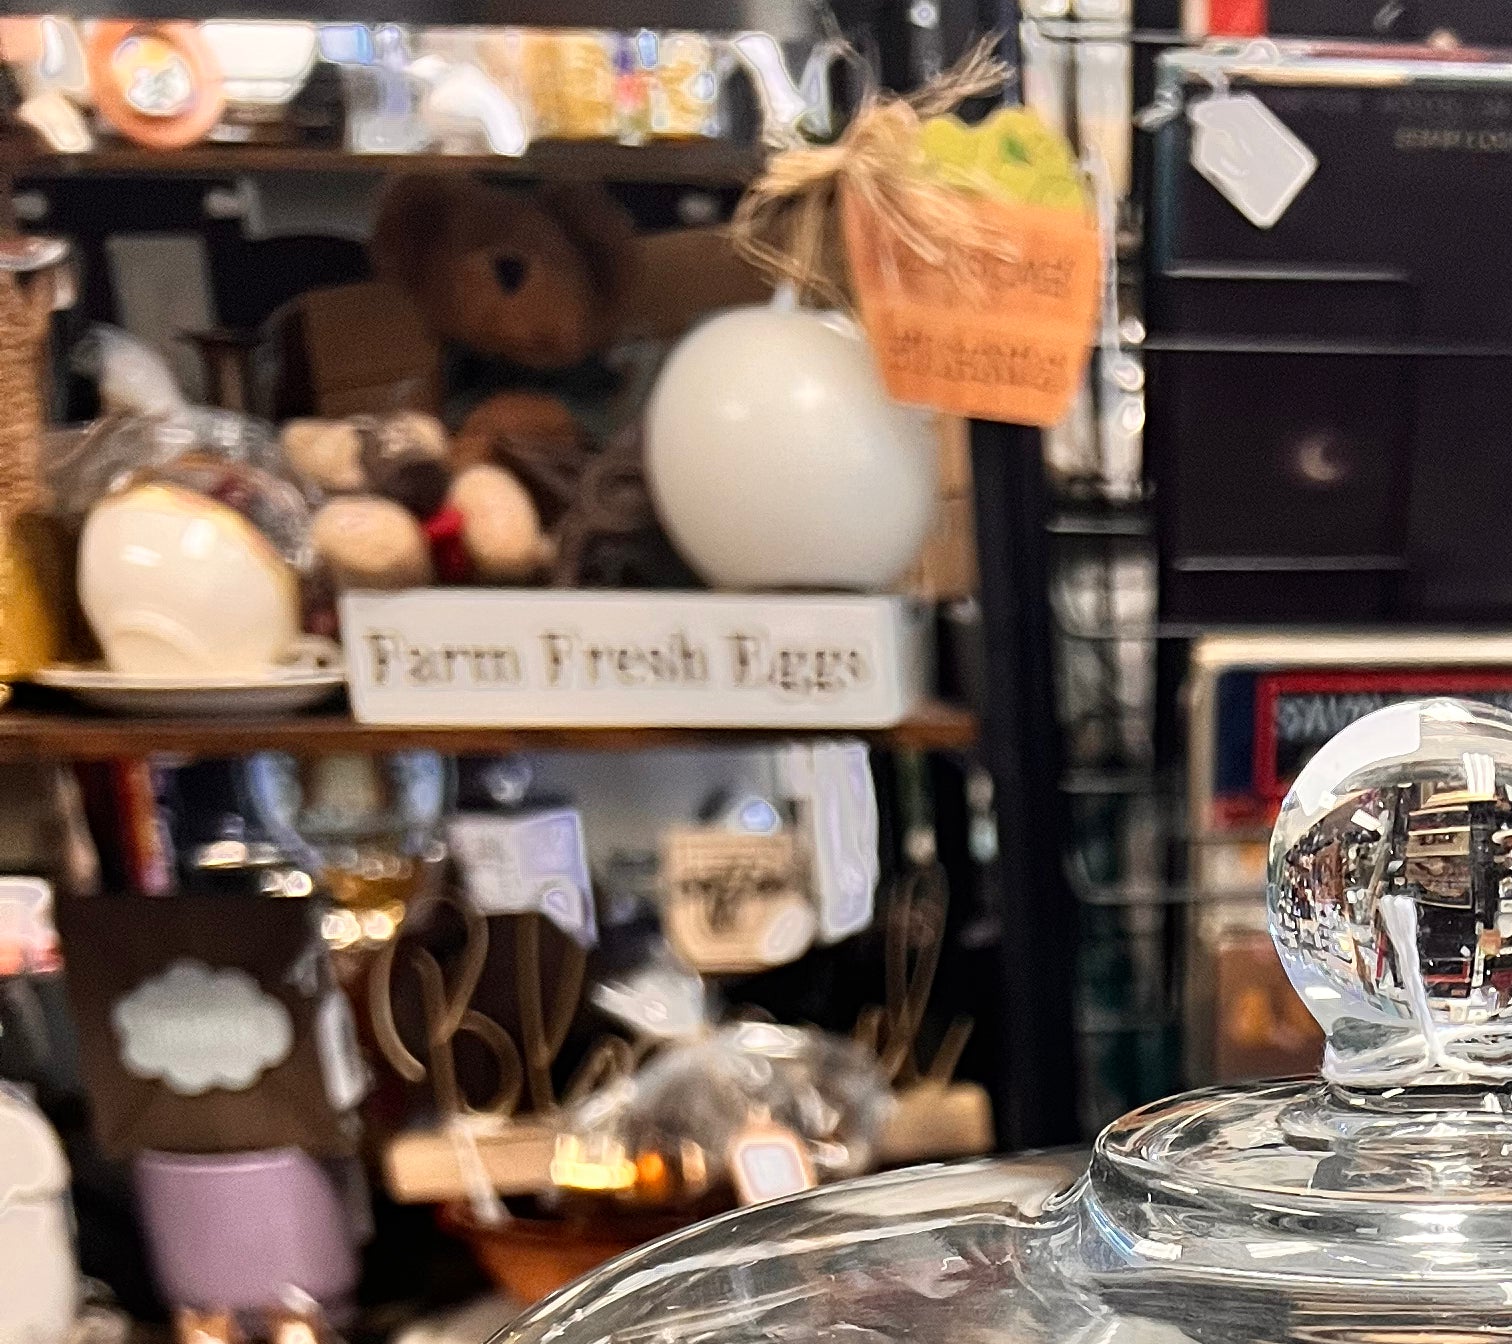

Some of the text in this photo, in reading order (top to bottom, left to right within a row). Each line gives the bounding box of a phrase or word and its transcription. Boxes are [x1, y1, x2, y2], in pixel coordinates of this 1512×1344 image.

[365, 620, 873, 698] Farm Fresh Eggs
